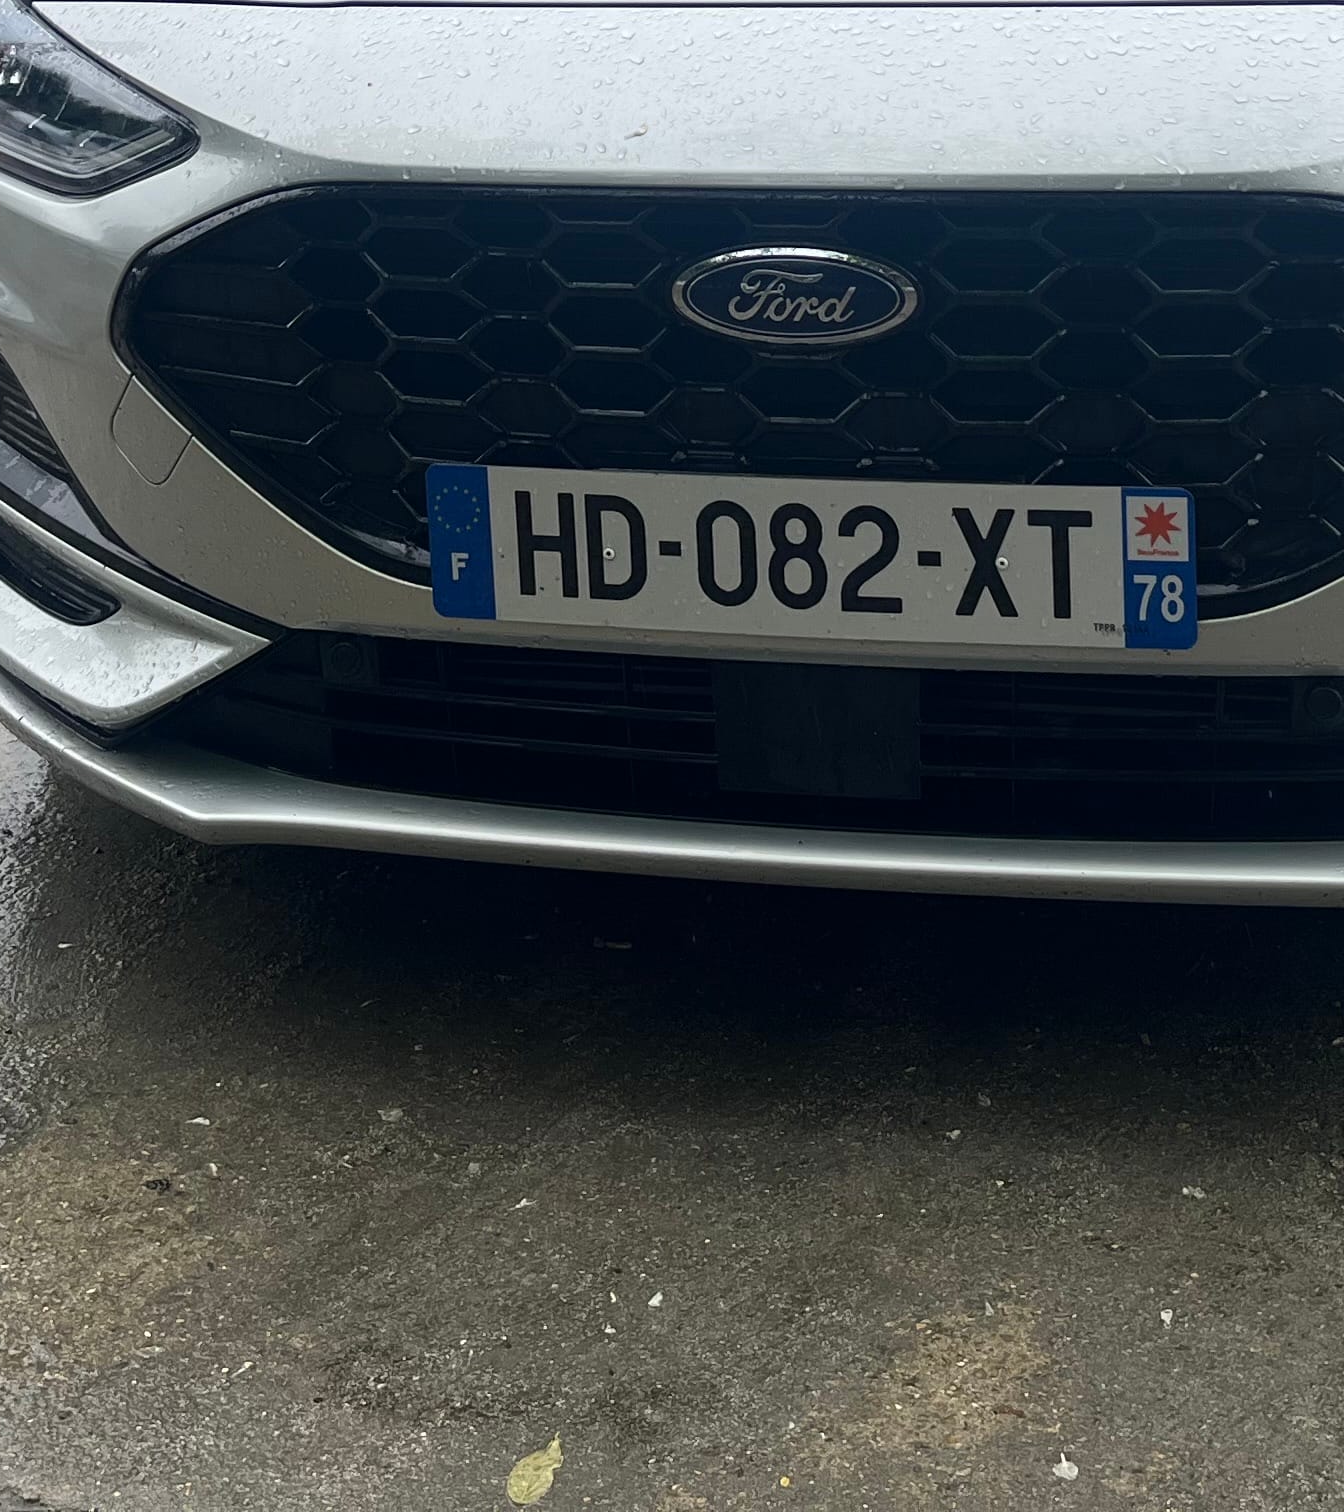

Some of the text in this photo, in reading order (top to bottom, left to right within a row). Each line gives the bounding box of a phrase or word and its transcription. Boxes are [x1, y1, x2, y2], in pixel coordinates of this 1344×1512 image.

[728, 269, 856, 323] Ford
[451, 552, 469, 580] F
[515, 491, 1093, 619] HD-082-XT
[1133, 574, 1185, 623] 78
